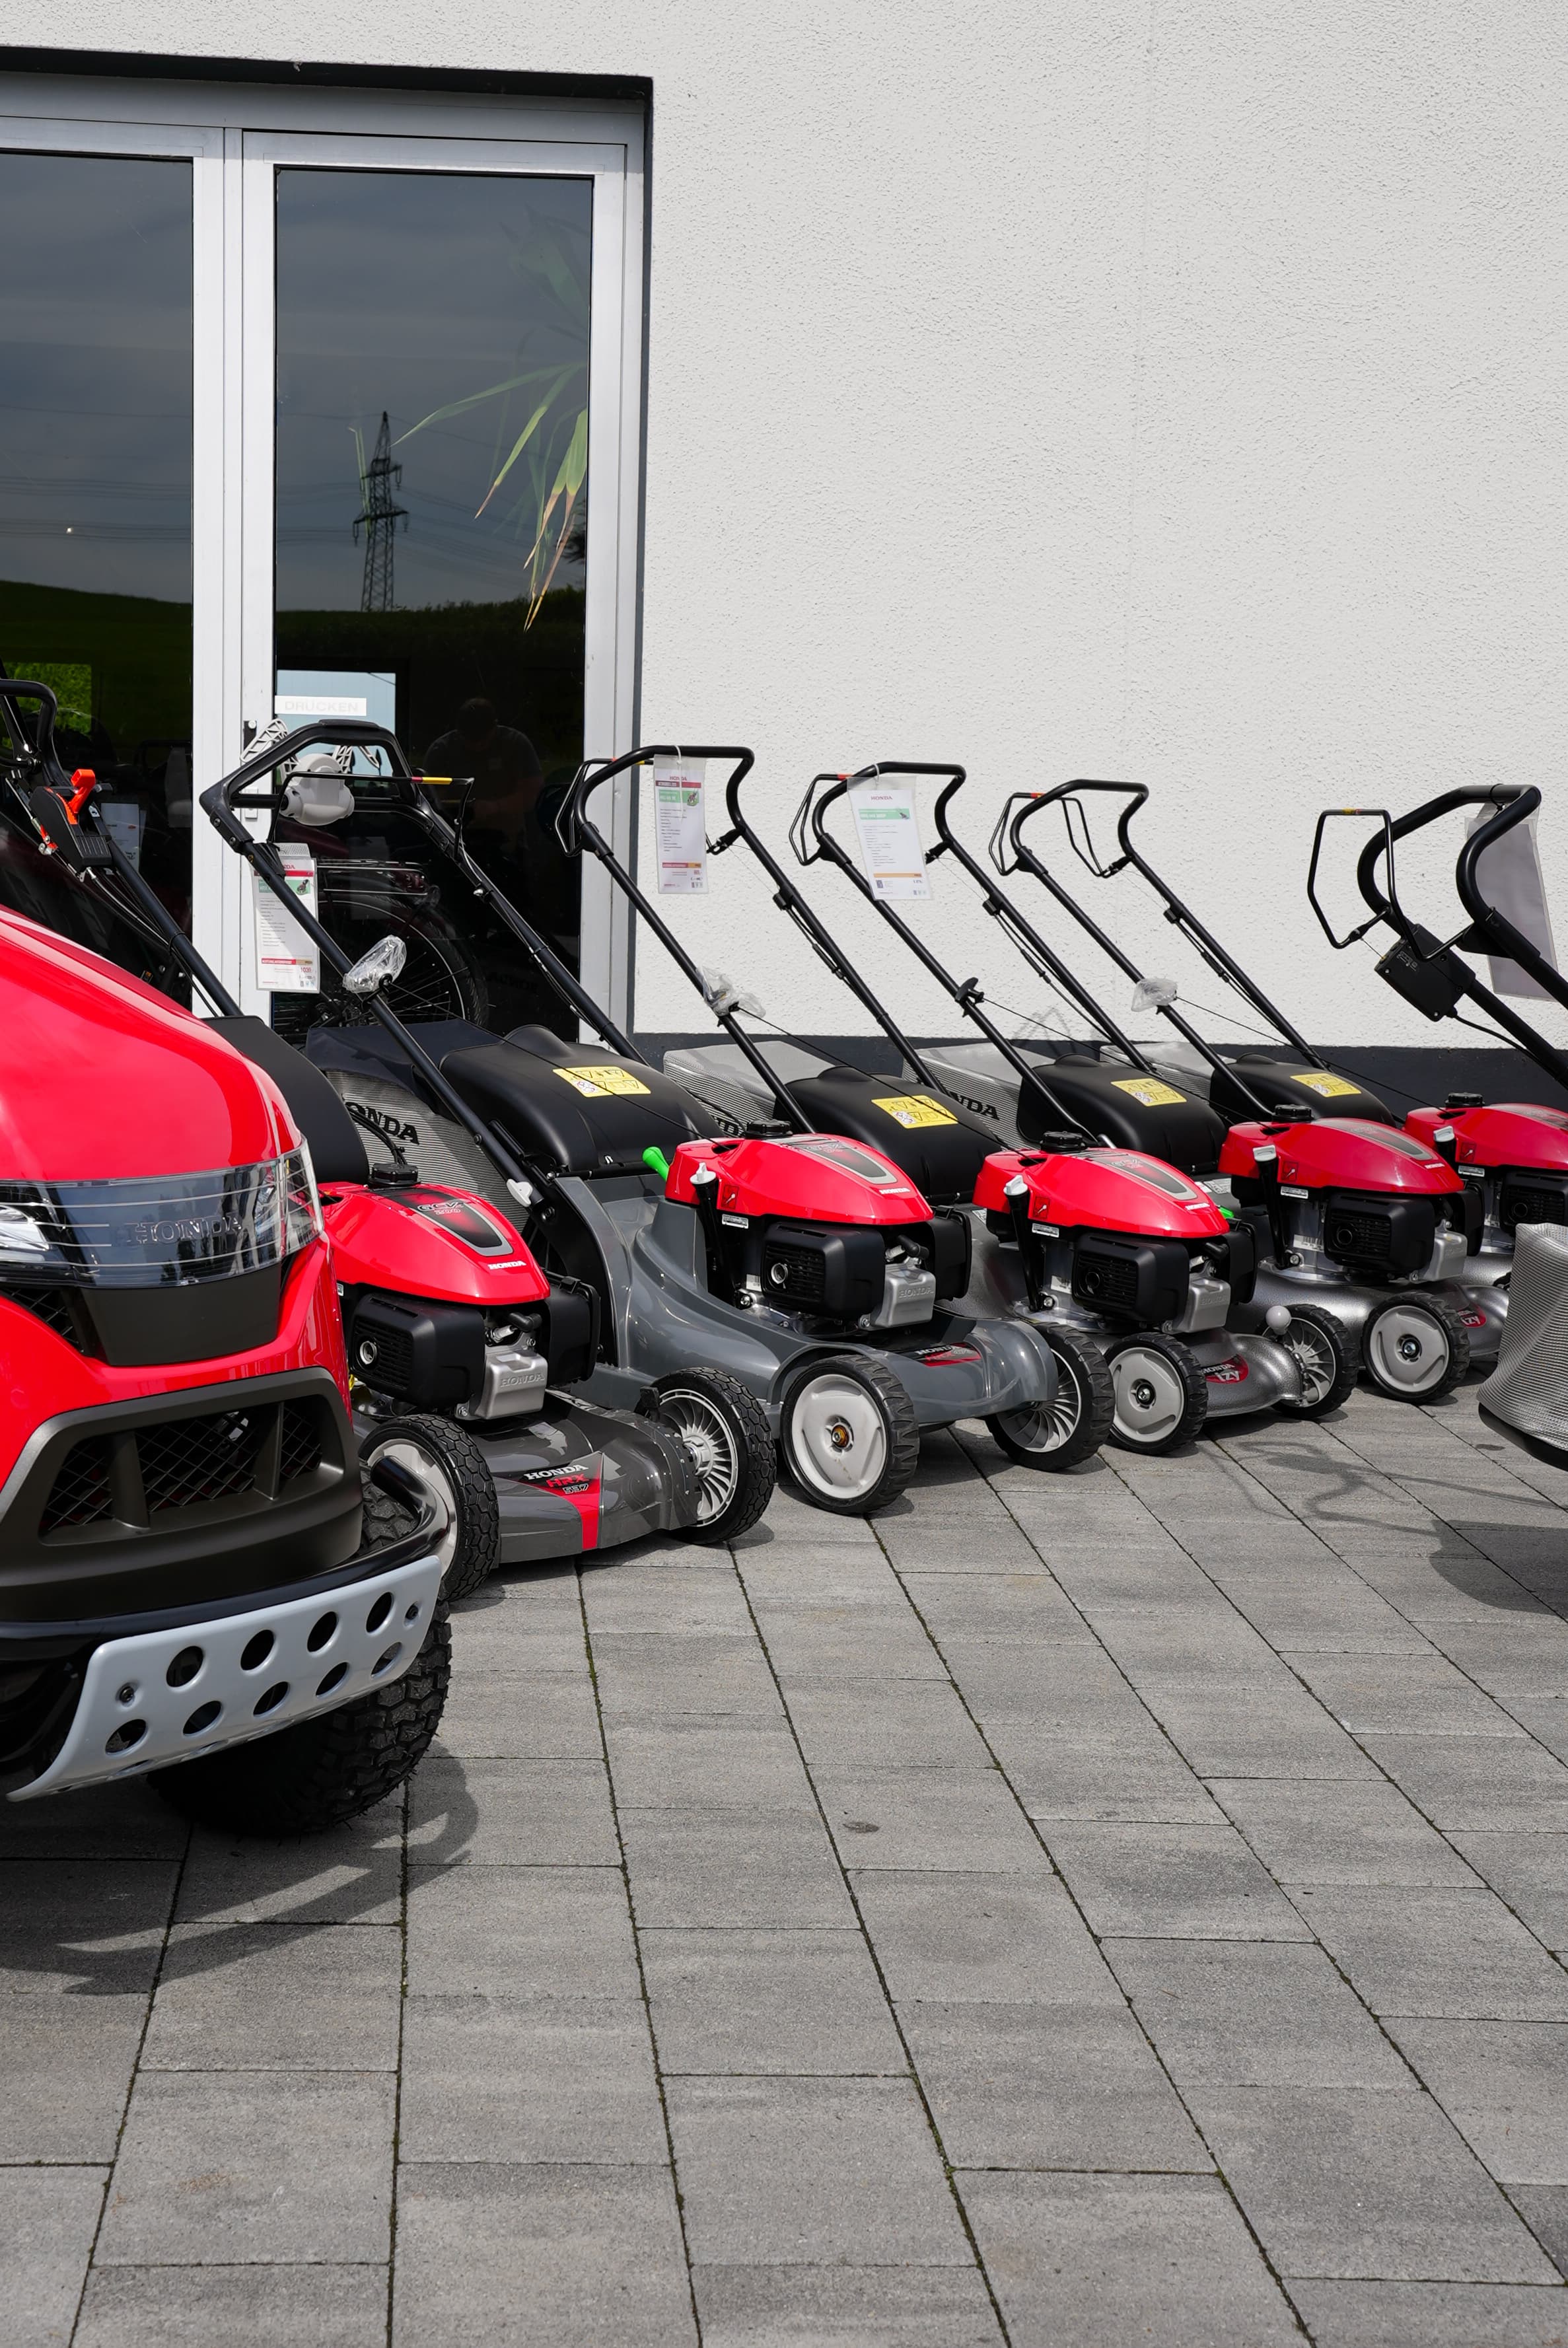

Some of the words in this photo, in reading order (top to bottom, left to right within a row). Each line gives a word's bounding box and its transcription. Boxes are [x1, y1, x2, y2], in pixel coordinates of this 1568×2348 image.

[950, 1091, 999, 1121] NDA
[341, 1093, 419, 1145] ONDA
[125, 1213, 242, 1244] HONDA
[487, 1260, 526, 1270] HONDA
[501, 1373, 545, 1388] HONDA
[524, 1464, 589, 1480] HONDA
[546, 1474, 590, 1487] HRX
